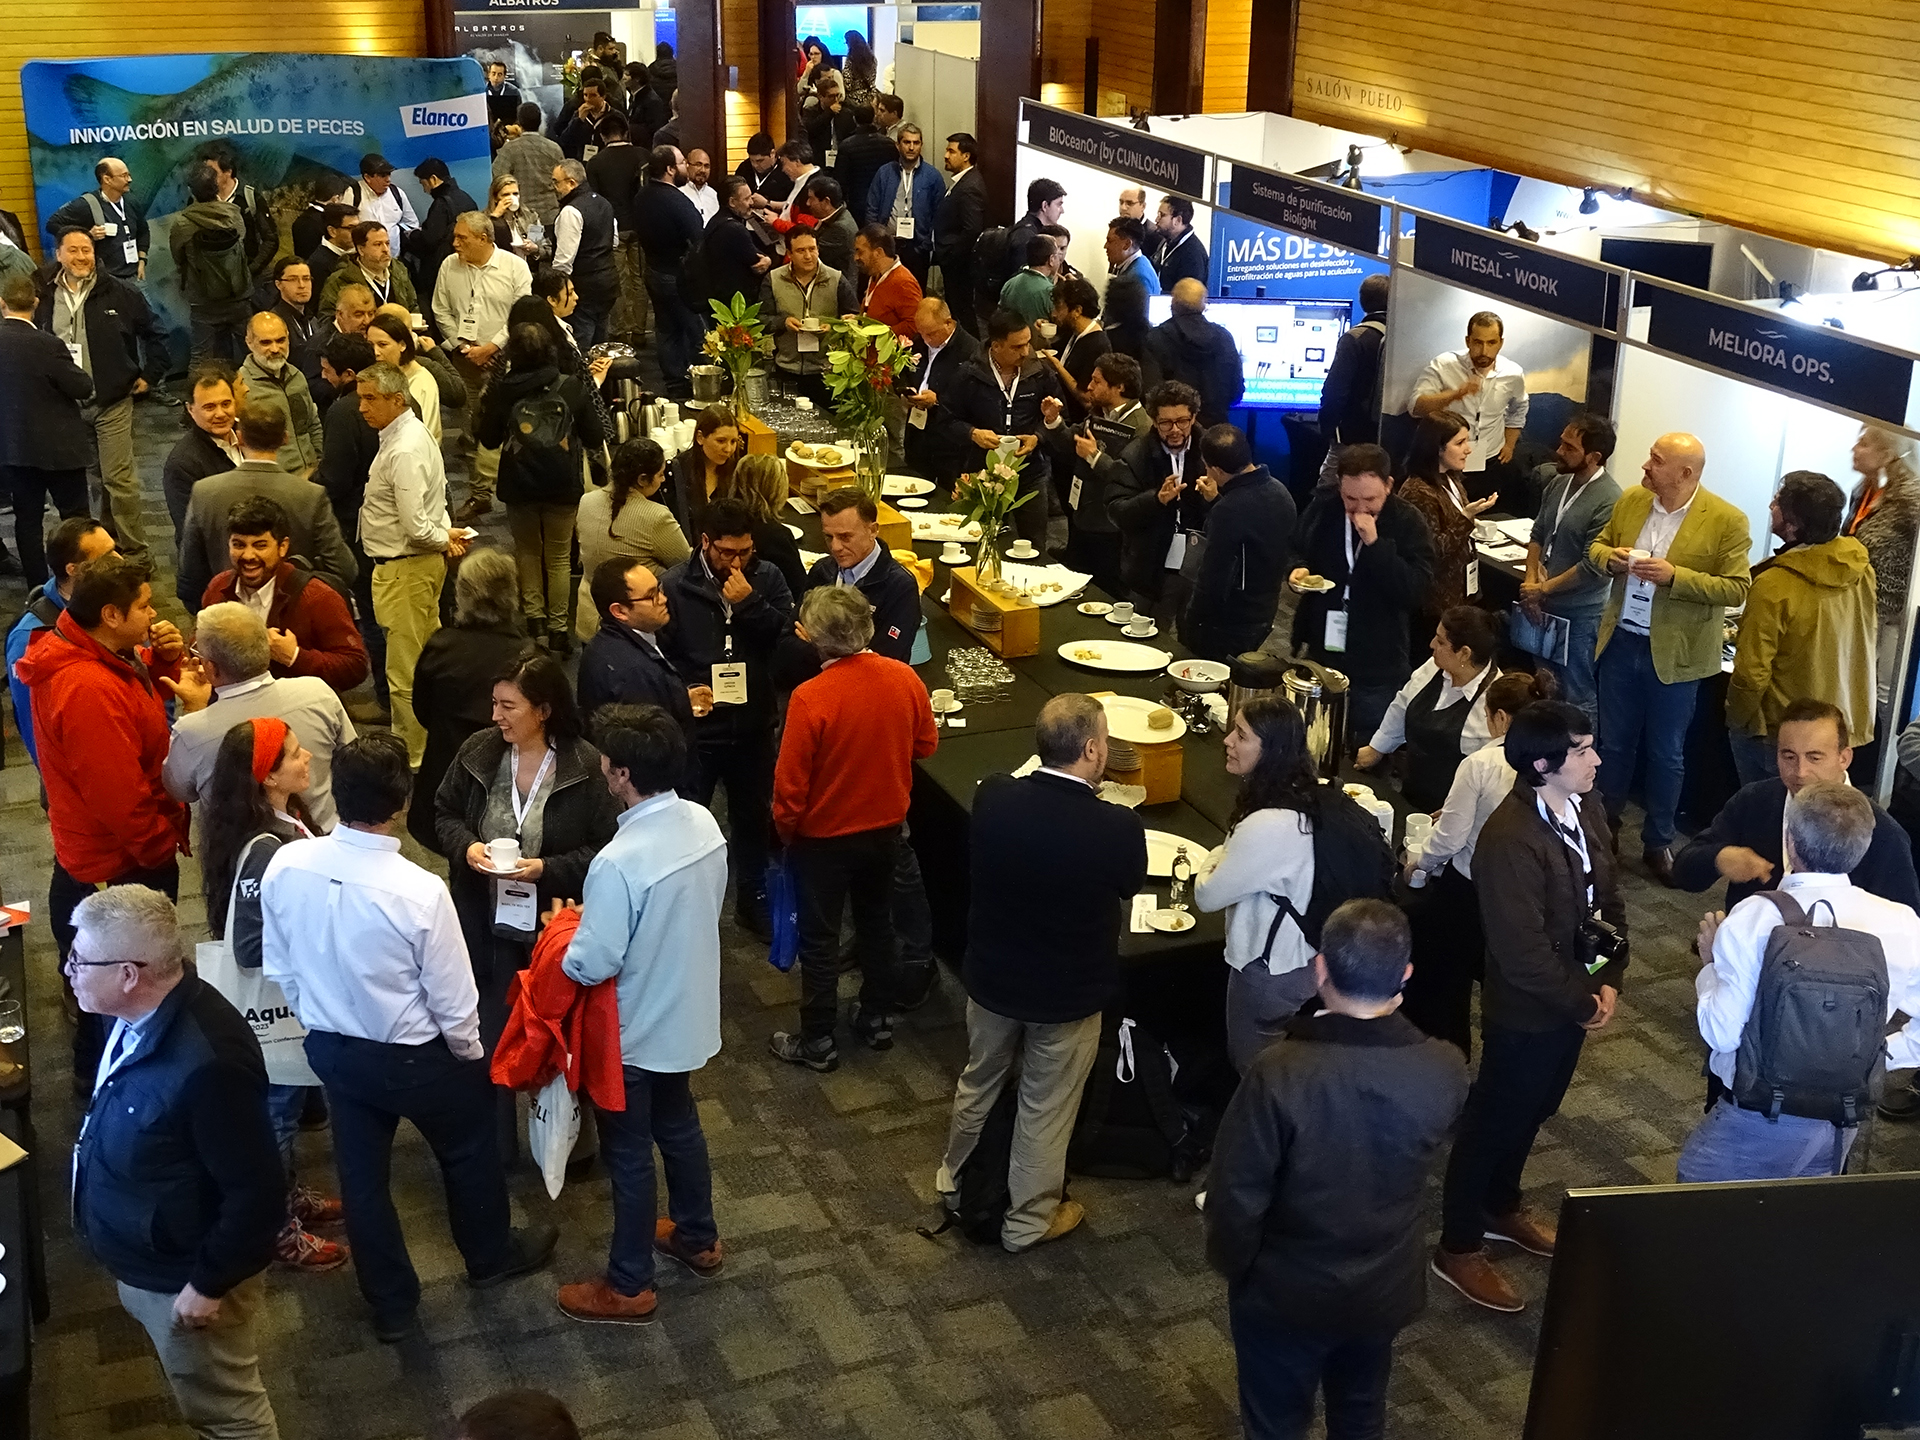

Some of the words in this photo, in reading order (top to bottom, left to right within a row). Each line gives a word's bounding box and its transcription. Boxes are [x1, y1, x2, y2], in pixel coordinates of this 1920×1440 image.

[1306, 78, 1352, 101] SALÓN
[1360, 88, 1403, 112] PUELO
[69, 118, 180, 145] INNOVACIÓN
[182, 119, 209, 137] EN
[211, 118, 275, 136] SALUD
[278, 118, 303, 134] DE
[306, 118, 366, 136] PECES
[411, 107, 469, 127] Elanco
[1049, 125, 1098, 156] BIOceanOr
[1099, 141, 1116, 165] (by
[1116, 147, 1180, 186] CUNLOGAN)
[1252, 182, 1285, 203] Sistema
[1286, 192, 1298, 207] de
[1299, 197, 1353, 223] purificación
[1283, 208, 1318, 232] Biolight
[1227, 231, 1282, 264] MÁS
[1284, 235, 1317, 260] DE
[1226, 272, 1273, 281] microfiltración
[1274, 271, 1284, 279] de
[1283, 270, 1304, 280] aguas
[1303, 270, 1320, 279] para
[1319, 268, 1327, 276] la
[1227, 263, 1266, 273] Entregando
[1265, 262, 1300, 271] soluciones
[1309, 258, 1350, 268] desinfección
[1451, 248, 1504, 279] INTESAL
[1514, 267, 1559, 297] WORK
[1708, 327, 1788, 370] MELIORA
[1791, 353, 1835, 385] OPS.
[246, 1006, 295, 1024] Aqu
